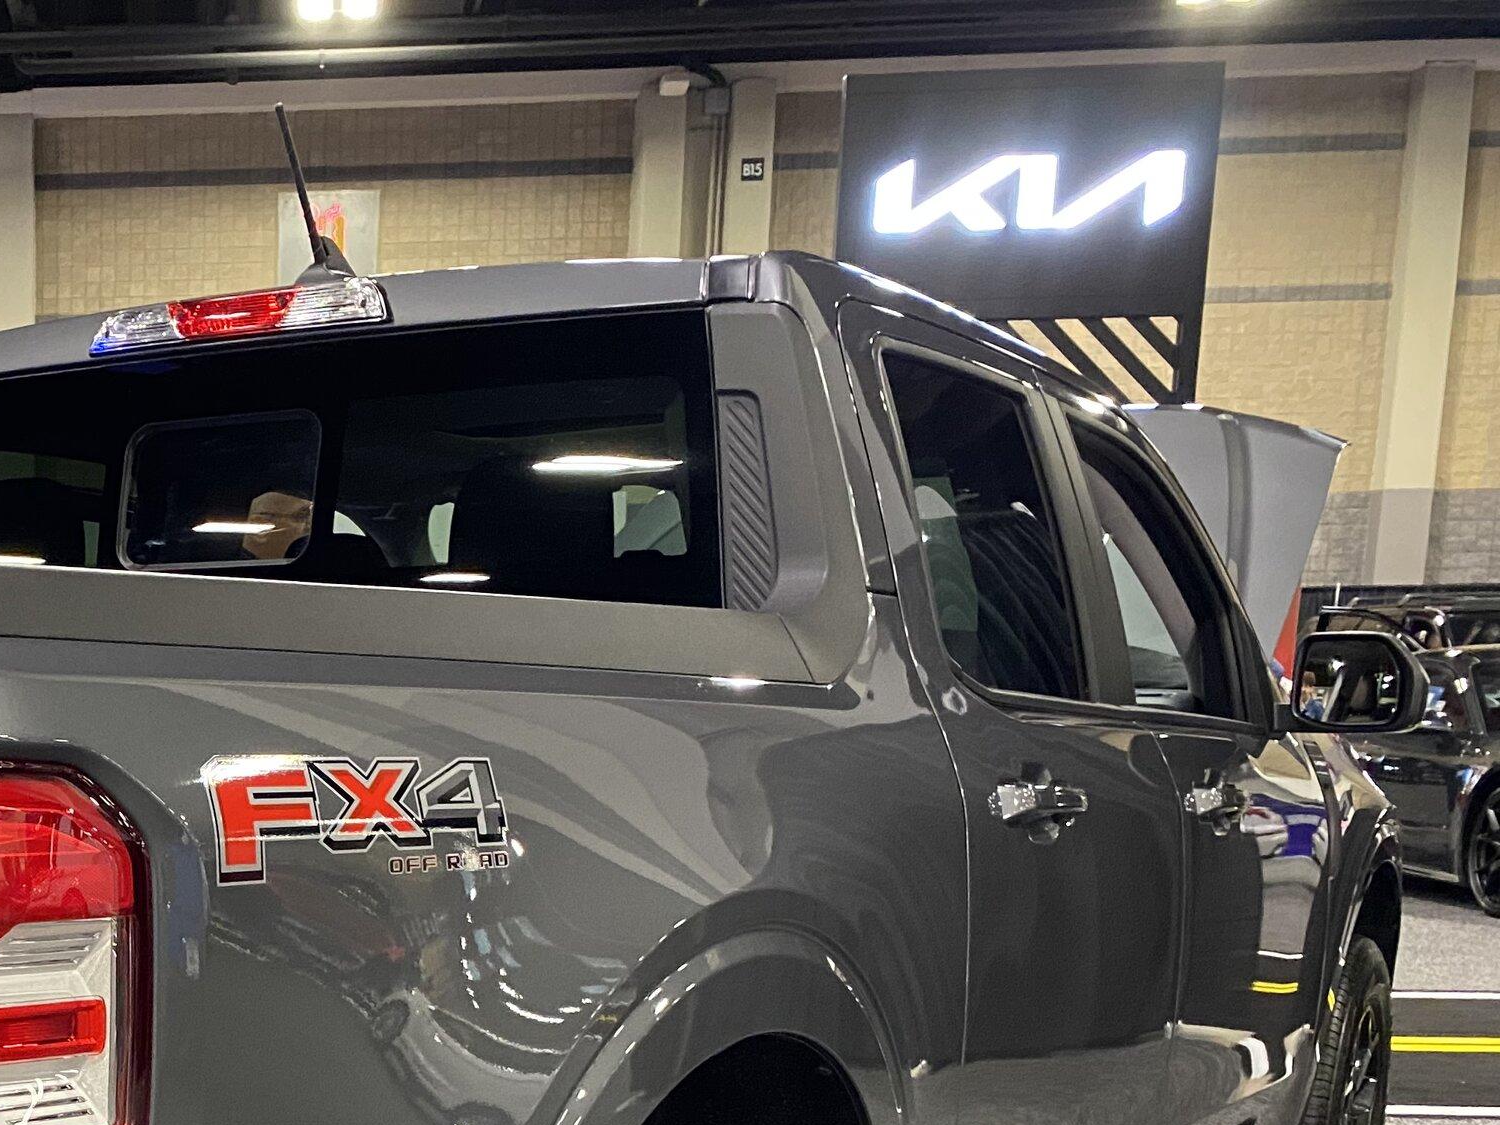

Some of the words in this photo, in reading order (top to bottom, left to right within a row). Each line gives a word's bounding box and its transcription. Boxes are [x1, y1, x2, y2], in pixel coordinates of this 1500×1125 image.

[742, 162, 763, 177] B15
[873, 149, 1186, 234] KIA
[200, 754, 508, 886] FX4
[388, 855, 437, 874] OFF
